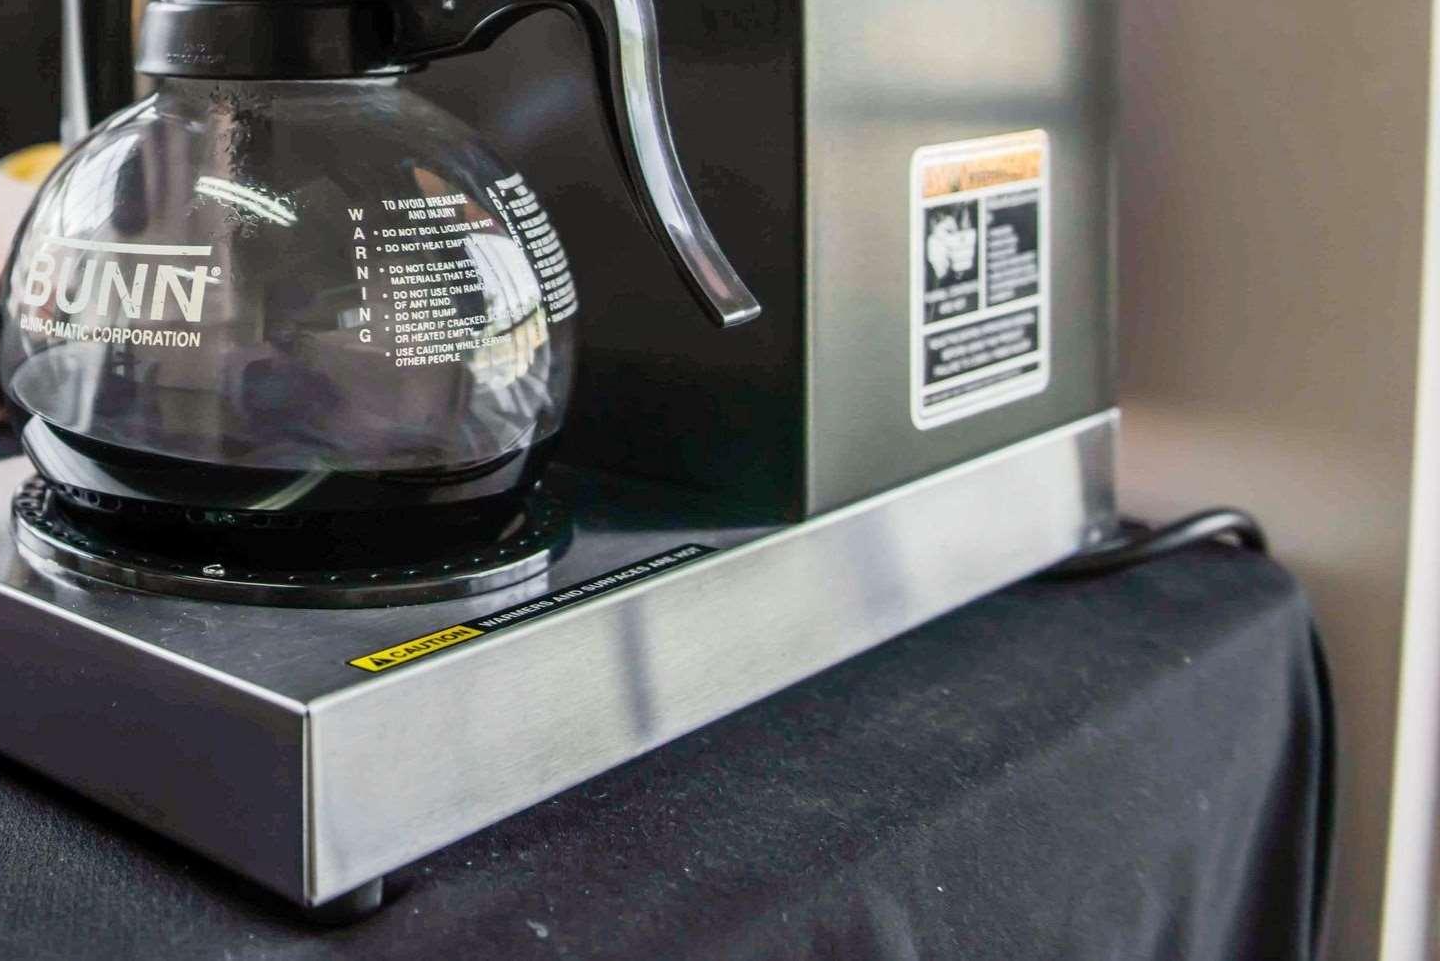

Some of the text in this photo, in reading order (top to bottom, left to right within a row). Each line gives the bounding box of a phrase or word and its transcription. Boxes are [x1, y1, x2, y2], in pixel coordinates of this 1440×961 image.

[382, 193, 468, 210] TO AVOID BREAKAGE
[408, 207, 456, 220] AND INJURY
[382, 229, 397, 238] DO
[399, 227, 417, 237] NOT
[419, 225, 440, 236] BOIL
[441, 223, 471, 235] LIQUIDS
[471, 221, 480, 230] IN
[385, 244, 399, 253] DO
[401, 242, 420, 252] NOT
[421, 240, 444, 251] HEAT
[389, 265, 404, 274] DO
[405, 264, 424, 274] NOT
[427, 261, 455, 273] CLEAN
[390, 273, 441, 285] MATERIALS
[442, 271, 464, 282] THAT
[23, 249, 210, 322] BUNN
[393, 291, 408, 300] DO
[409, 289, 428, 299] NOT
[430, 287, 448, 297] USE
[449, 285, 462, 295] ON
[394, 297, 451, 310] OF ANY KIND
[395, 308, 457, 321] DO NOT BUMP
[20, 314, 201, 347] BUNN-O-MATIC CORPORATION
[395, 321, 435, 333] DISCARD
[437, 320, 446, 330] IF
[395, 328, 474, 343] OR HEATED EMPTY
[396, 347, 414, 357] USE
[416, 343, 454, 355] CAUTION
[455, 339, 480, 350] WHILE
[395, 353, 461, 367] OTHER PEOPLE
[389, 628, 469, 660] CAUTION
[478, 599, 554, 627] WARMERS
[553, 589, 584, 602] AND
[581, 565, 651, 592] SURFACES
[649, 556, 677, 570] ARE
